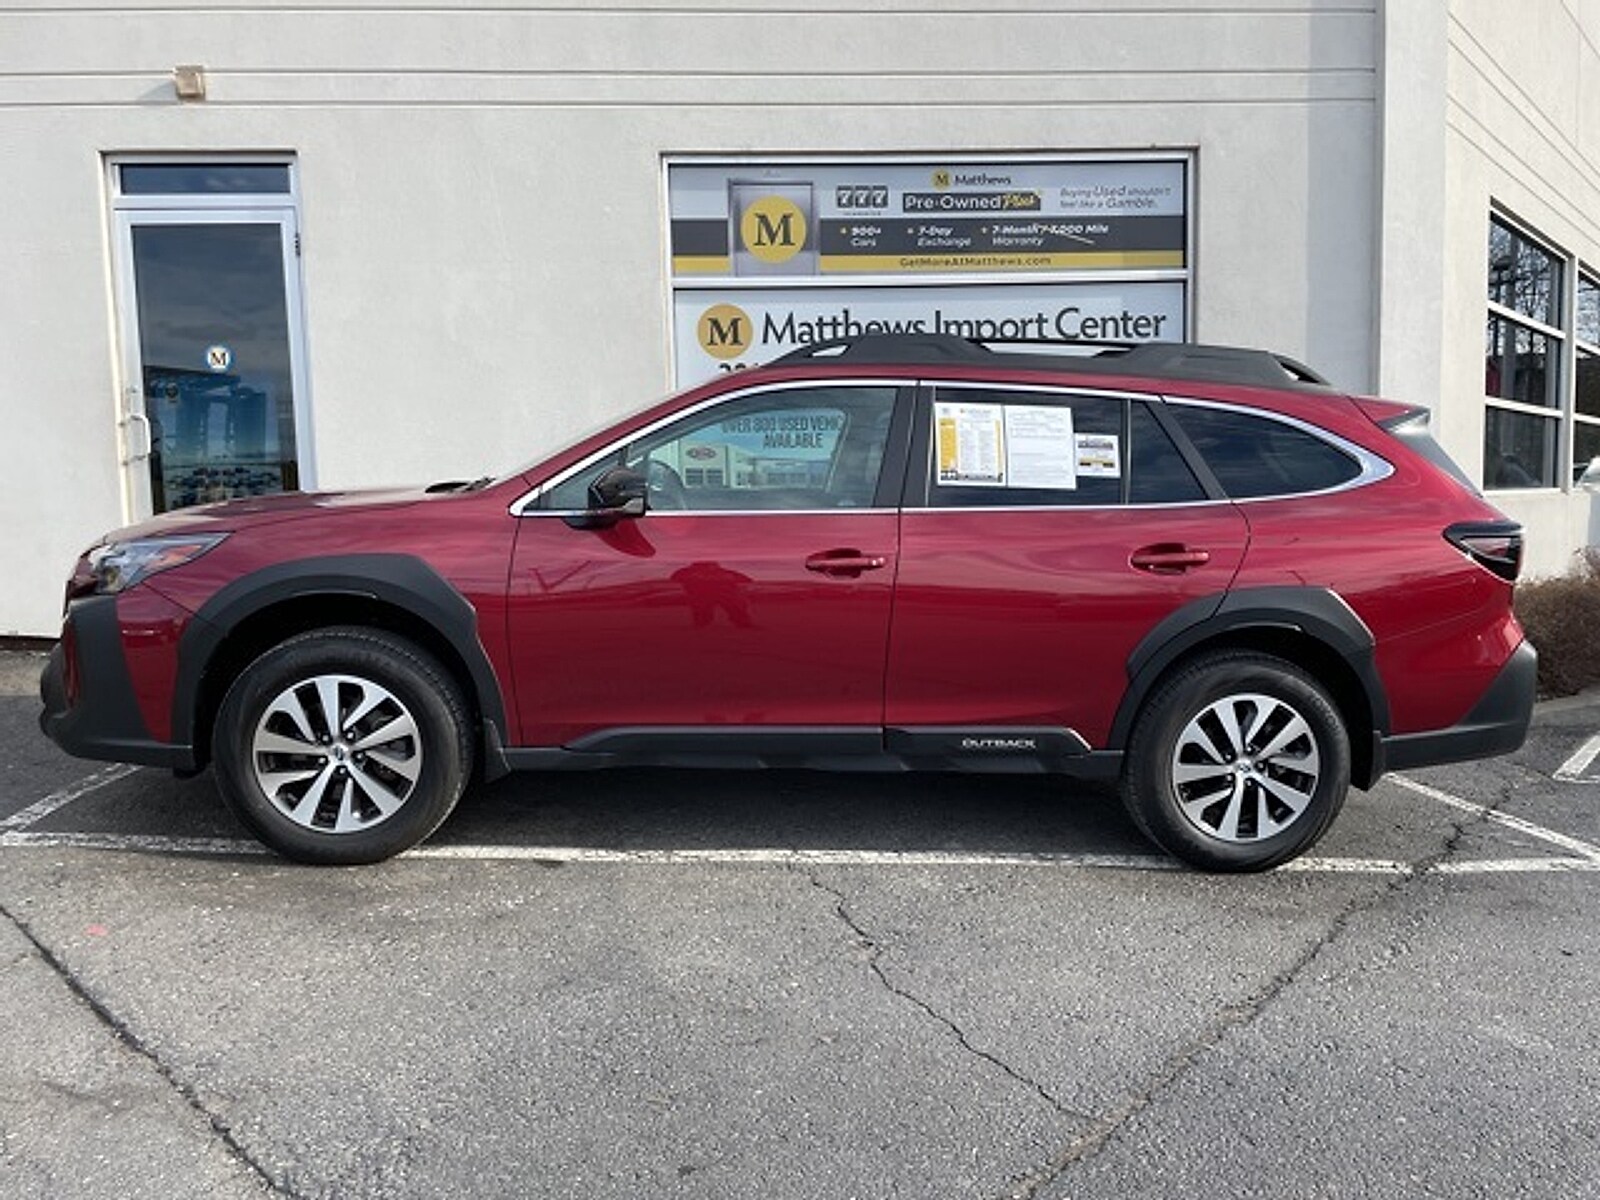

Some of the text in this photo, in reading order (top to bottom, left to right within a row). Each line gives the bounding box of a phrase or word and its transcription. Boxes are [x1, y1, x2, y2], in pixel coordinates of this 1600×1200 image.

[954, 173, 1011, 186] Matthews
[904, 194, 1001, 210] Pre-Owned
[754, 213, 795, 246] M
[850, 237, 876, 247] Cars
[917, 237, 971, 248] Exchange
[992, 237, 1043, 247] Warranty
[900, 256, 1051, 267] GetMoreAtMatthews.com
[707, 307, 1167, 346] M Matthews Import Center
[762, 432, 824, 449] AVAILABLE
[961, 737, 1037, 750] OUTBACK
